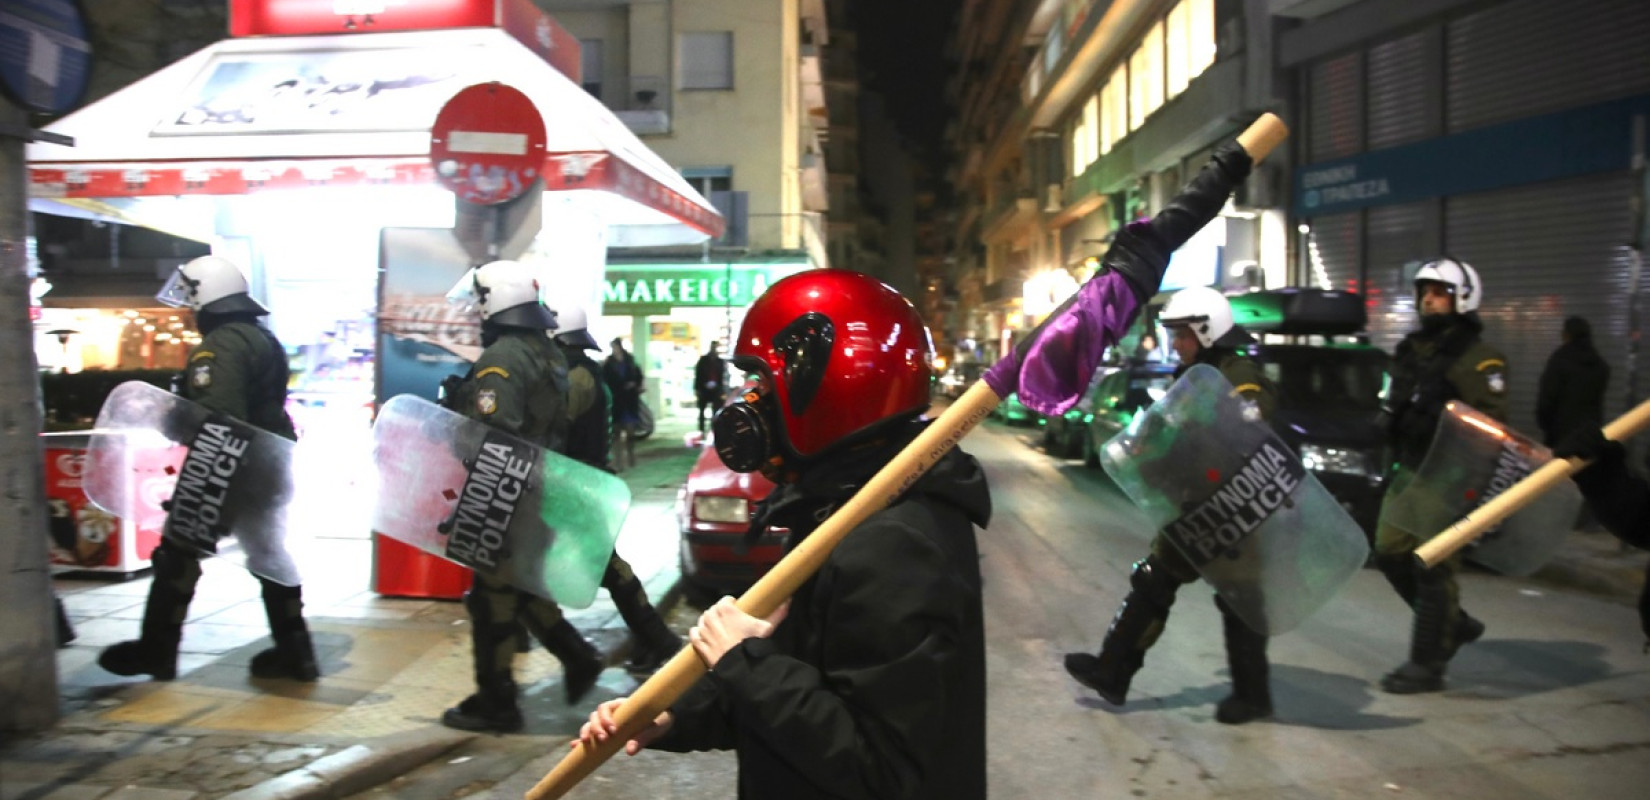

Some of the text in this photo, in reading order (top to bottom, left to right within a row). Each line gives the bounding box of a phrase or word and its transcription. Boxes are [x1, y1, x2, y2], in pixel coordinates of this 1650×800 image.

[173, 423, 231, 540] ΑΣΤΥΝΟΜΙΑ
[197, 435, 249, 543] POLICE
[448, 442, 513, 563] ΑΣΤΥΝΟΜΙΑ
[475, 455, 532, 567] POLICE
[1174, 444, 1287, 545] ΑΣΤΥΝΟΜΙΑ
[1196, 466, 1298, 559] POLICE
